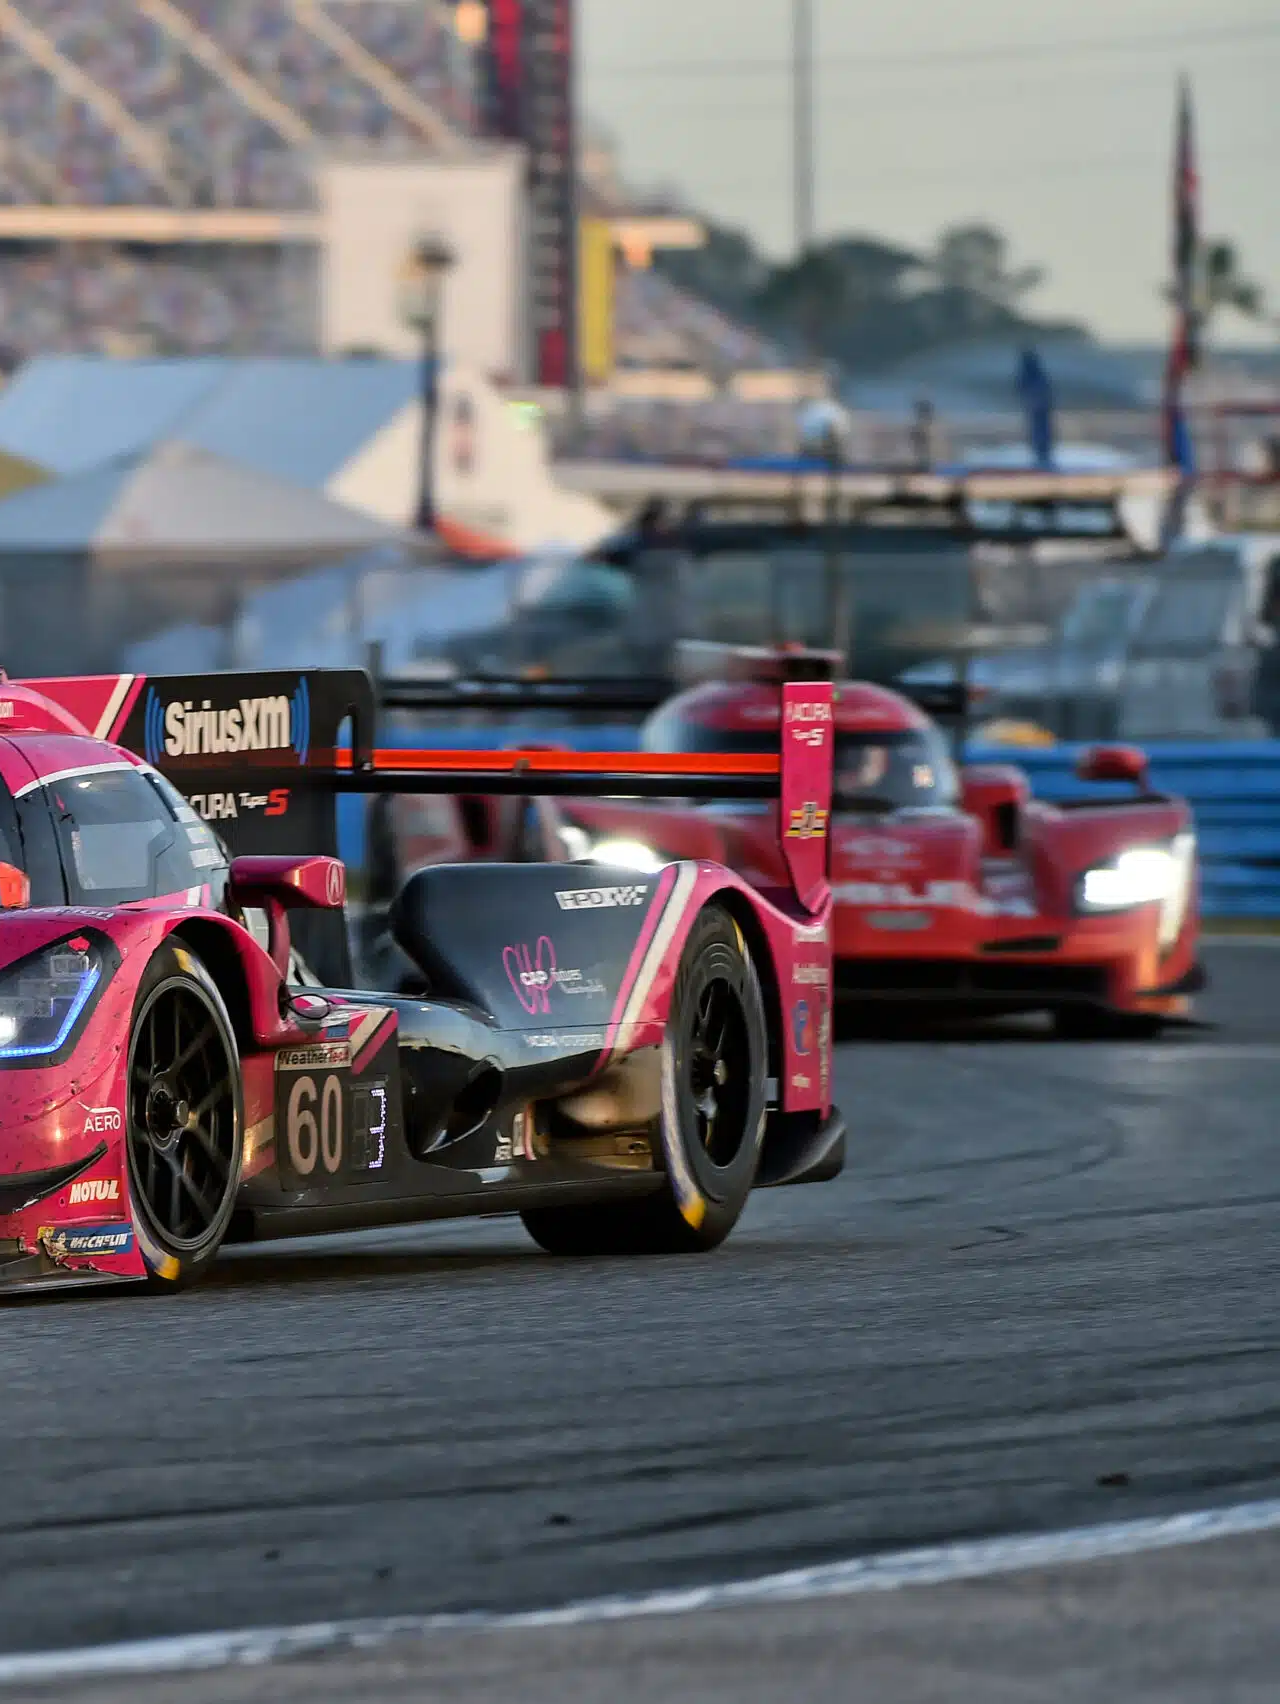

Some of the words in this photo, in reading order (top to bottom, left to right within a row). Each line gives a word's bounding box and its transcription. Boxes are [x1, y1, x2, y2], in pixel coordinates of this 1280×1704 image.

[186, 793, 238, 820] CURA
[264, 789, 290, 816] S
[84, 1115, 121, 1133] AERO
[287, 1074, 343, 1176] 60
[69, 1180, 120, 1205] MOTUL
